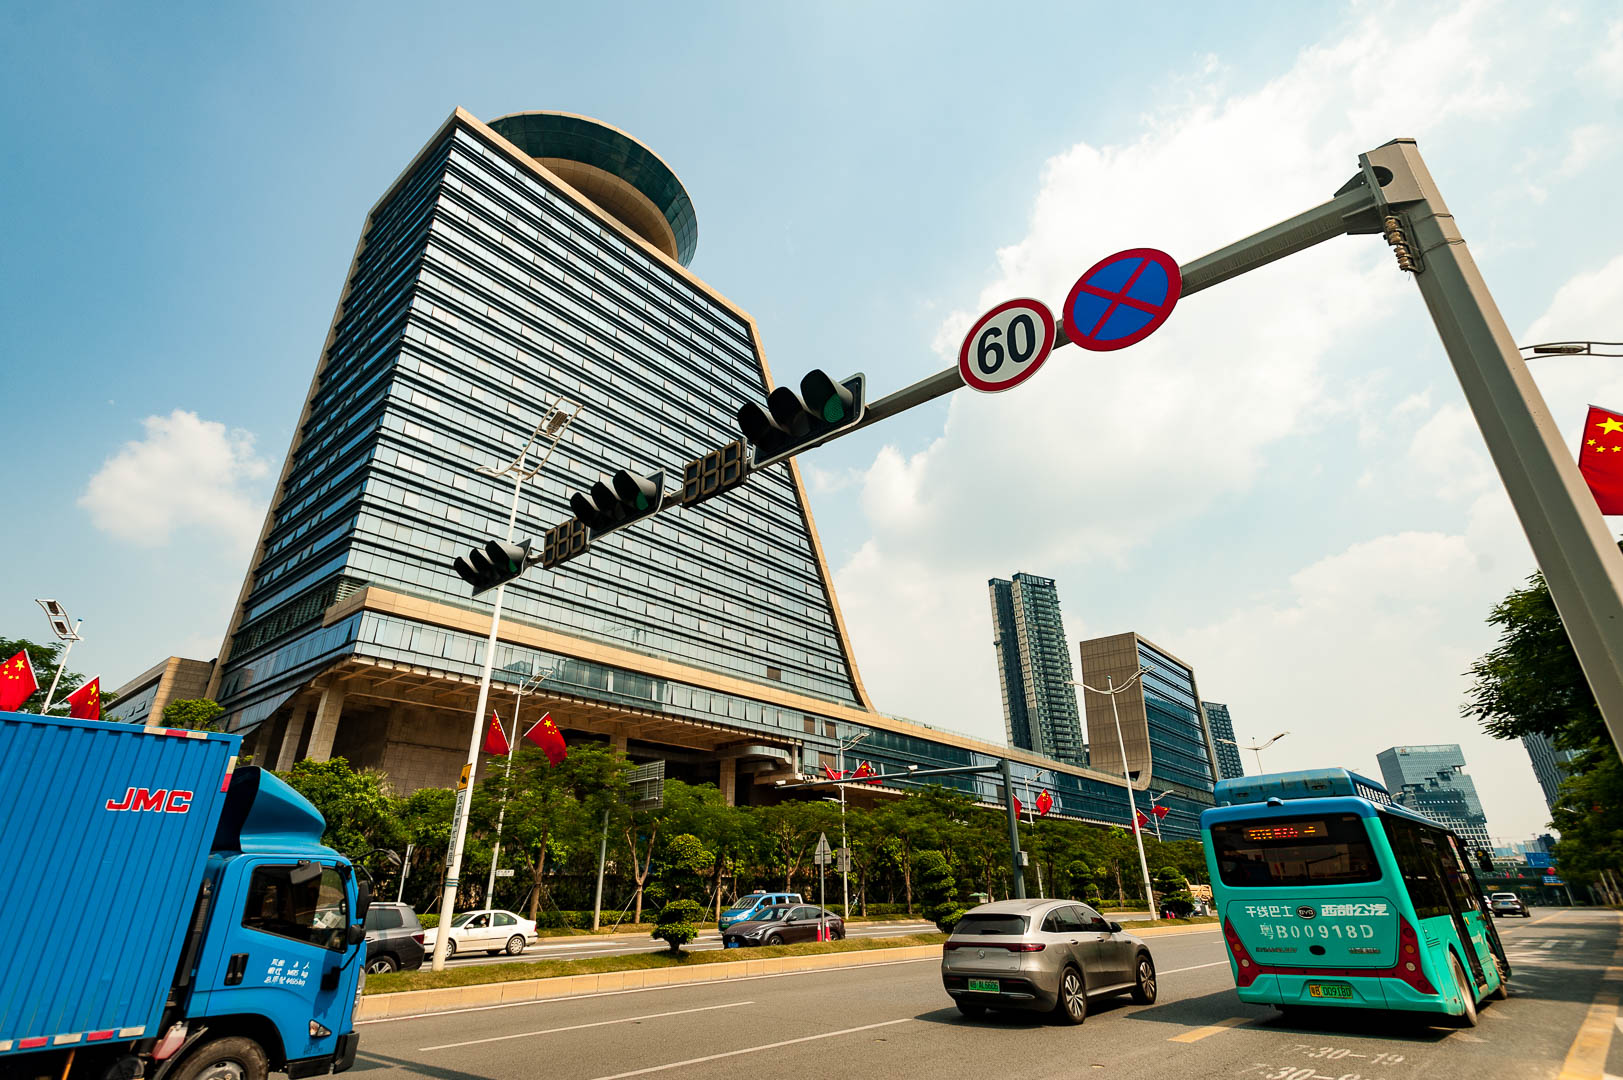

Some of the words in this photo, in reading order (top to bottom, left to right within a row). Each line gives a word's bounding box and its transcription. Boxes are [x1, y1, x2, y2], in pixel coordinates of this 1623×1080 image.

[977, 313, 1036, 375] 60
[105, 786, 193, 813] JMC
[1321, 903, 1390, 917] 西部公汽
